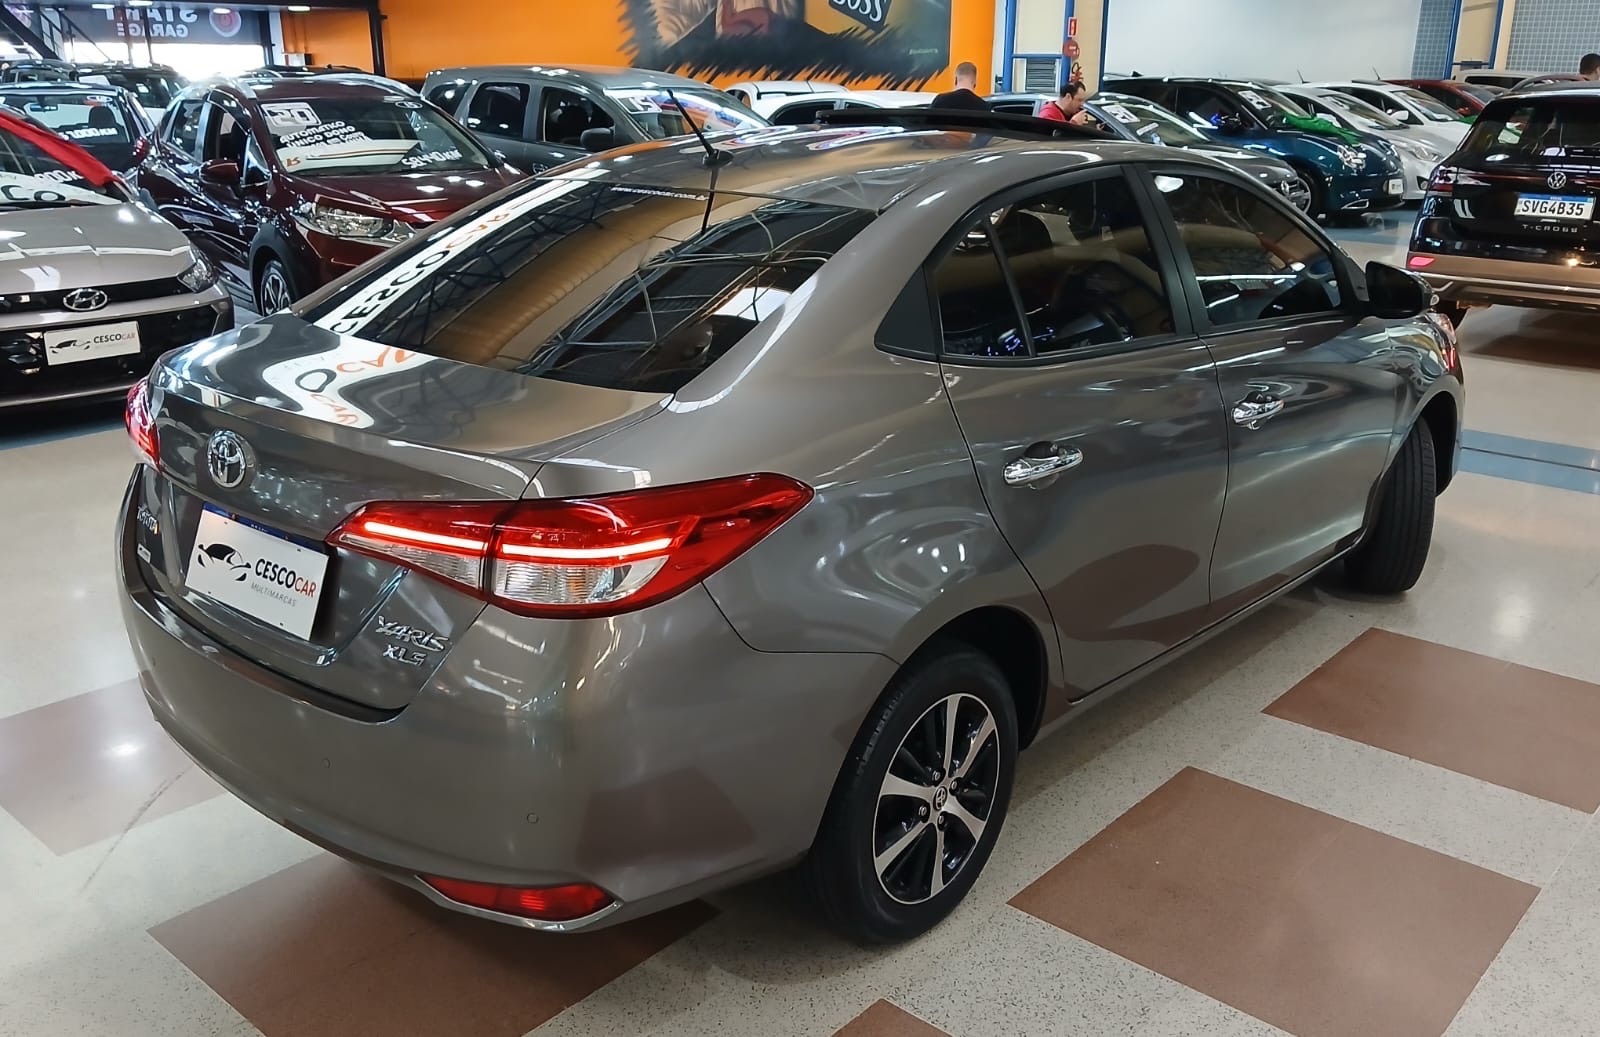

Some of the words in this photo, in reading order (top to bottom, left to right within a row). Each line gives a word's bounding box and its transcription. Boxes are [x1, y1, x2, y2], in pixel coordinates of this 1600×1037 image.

[1521, 200, 1585, 216] SVG4B35
[1522, 224, 1578, 233] T-CROSS
[93, 332, 136, 344] CESCOCAR
[255, 558, 317, 598] CESCOCAR
[250, 581, 297, 607] MULTIMARCAS
[376, 615, 449, 652] YARIS
[383, 644, 427, 666] XLS
